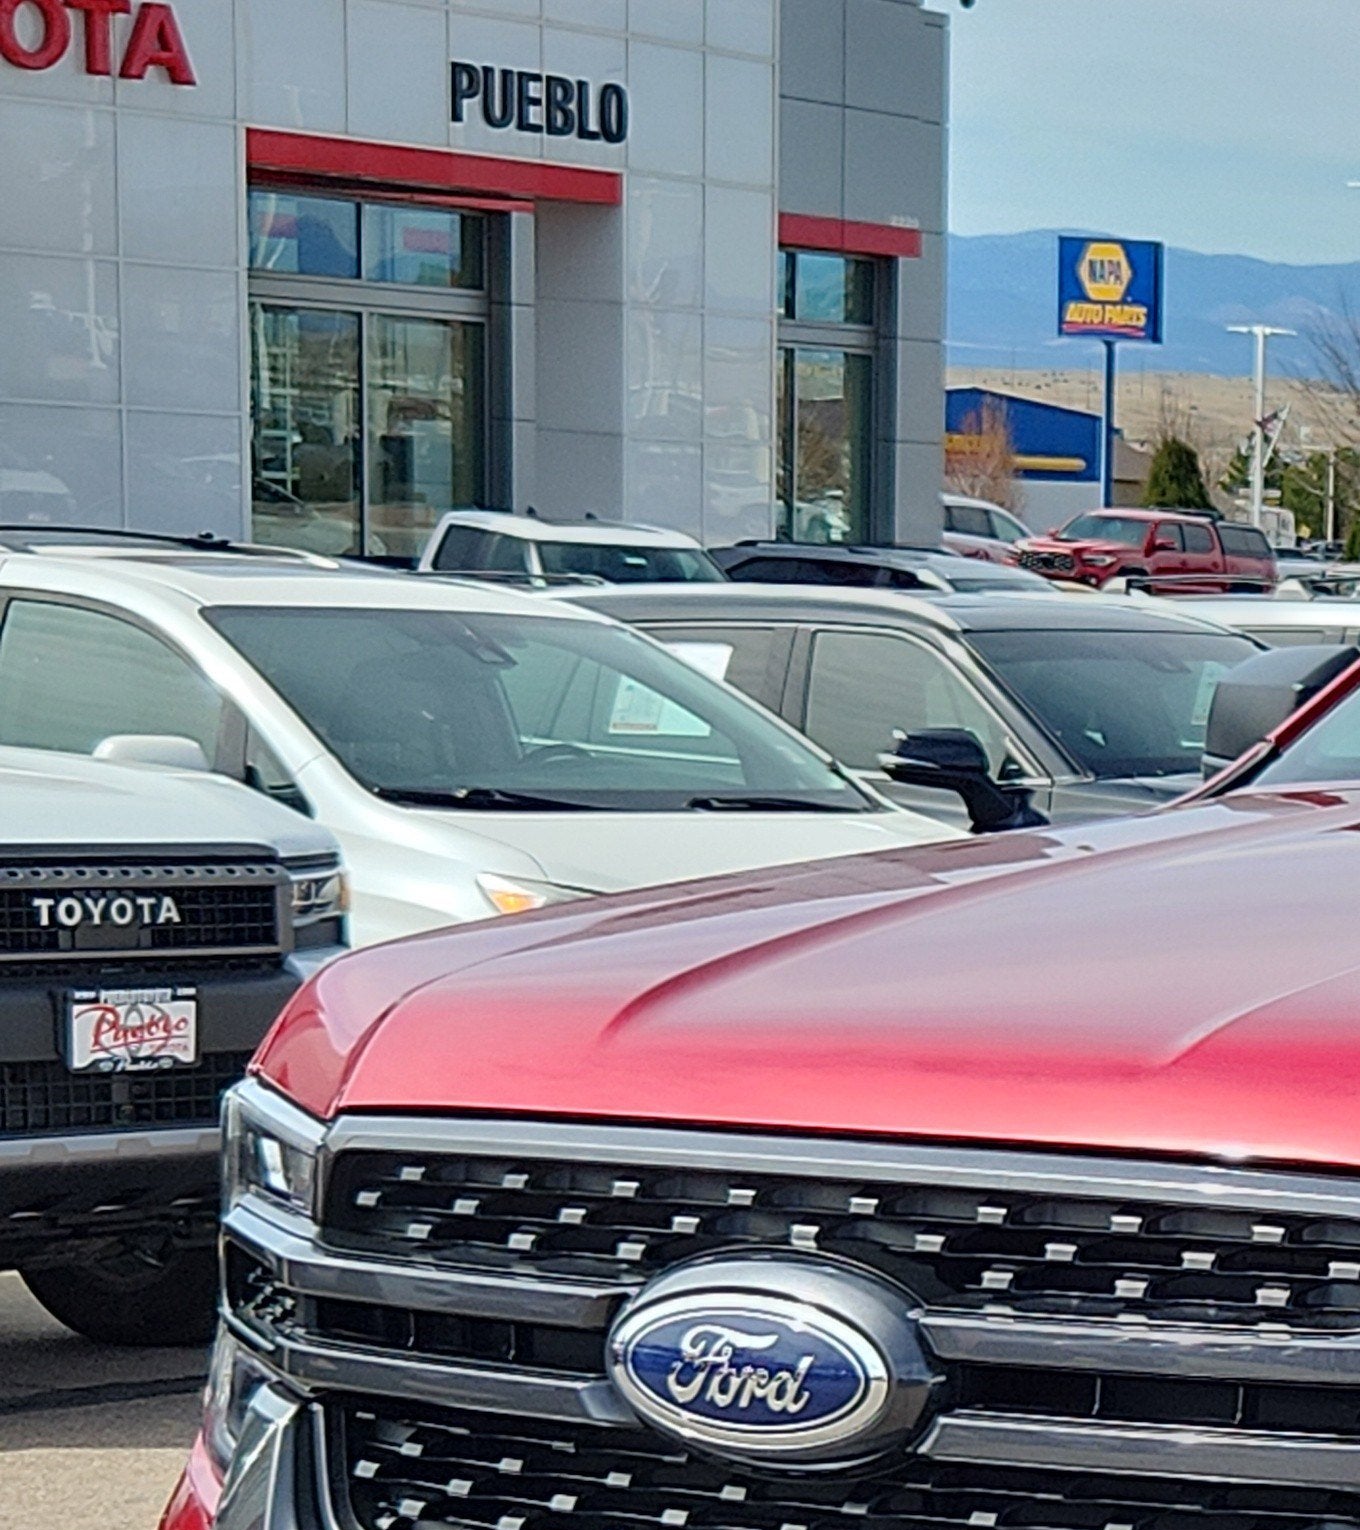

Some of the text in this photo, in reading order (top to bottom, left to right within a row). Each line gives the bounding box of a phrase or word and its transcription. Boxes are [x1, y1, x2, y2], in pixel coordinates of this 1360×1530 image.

[0, 0, 196, 85] OTA
[451, 61, 629, 144] PUEBLO
[1086, 259, 1122, 285] NAPA
[1065, 302, 1147, 327] AUTO PARTS
[32, 896, 181, 927] TOYOTA
[74, 1005, 189, 1047] Pueblo
[667, 1324, 815, 1413] Ford
